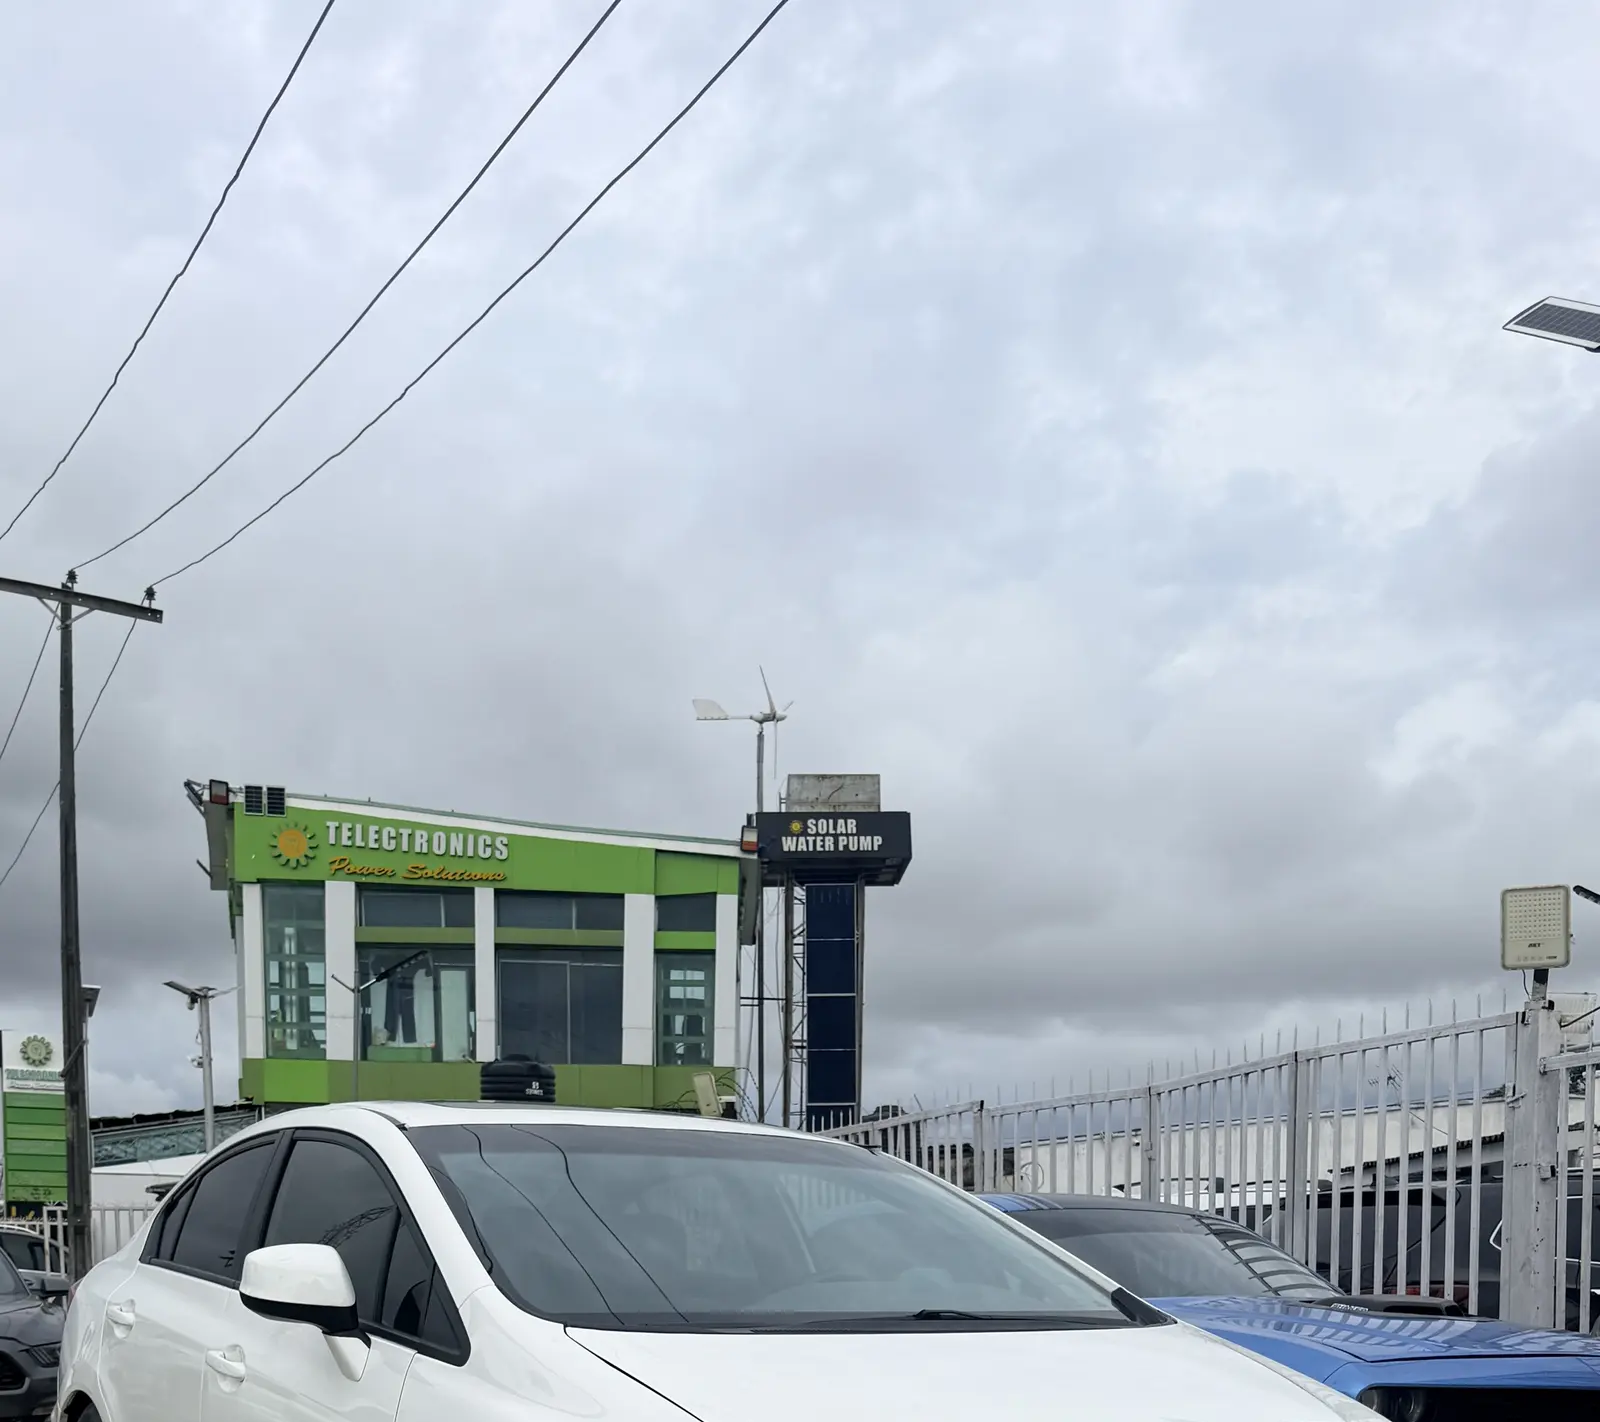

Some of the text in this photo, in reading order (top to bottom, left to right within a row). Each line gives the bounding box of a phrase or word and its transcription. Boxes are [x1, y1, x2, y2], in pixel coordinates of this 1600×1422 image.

[807, 818, 857, 834] SOLAR
[326, 821, 508, 860] TELECTRONICS
[781, 836, 883, 852] WATER PUMP
[329, 856, 507, 881] Power Solutions
